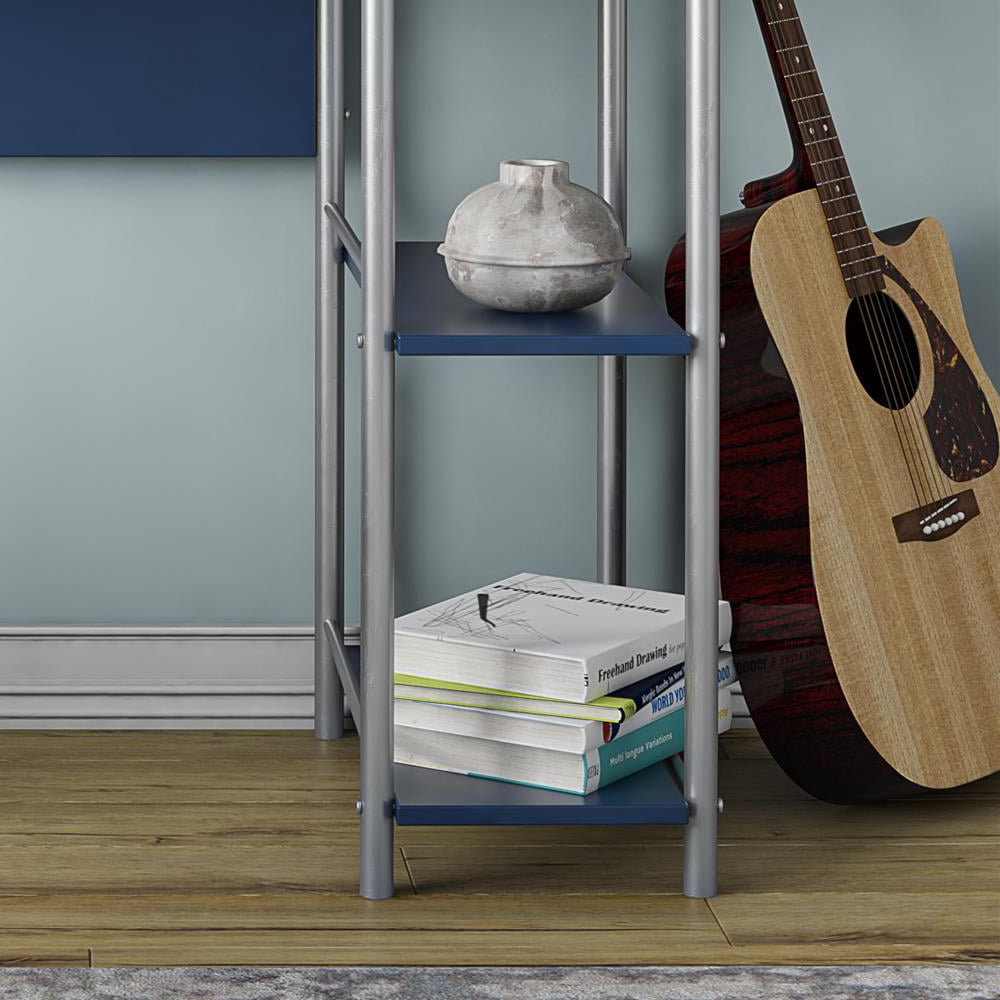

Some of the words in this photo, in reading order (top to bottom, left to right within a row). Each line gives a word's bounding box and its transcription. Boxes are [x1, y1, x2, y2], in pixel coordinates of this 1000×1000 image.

[493, 585, 584, 601] Freehand
[588, 598, 670, 614] Drawing
[598, 660, 634, 683] Freehand
[636, 644, 667, 666] Drawing
[651, 692, 673, 714] WORLD
[610, 752, 624, 766] Multi
[624, 744, 644, 759] langue
[645, 731, 673, 750] Variations
